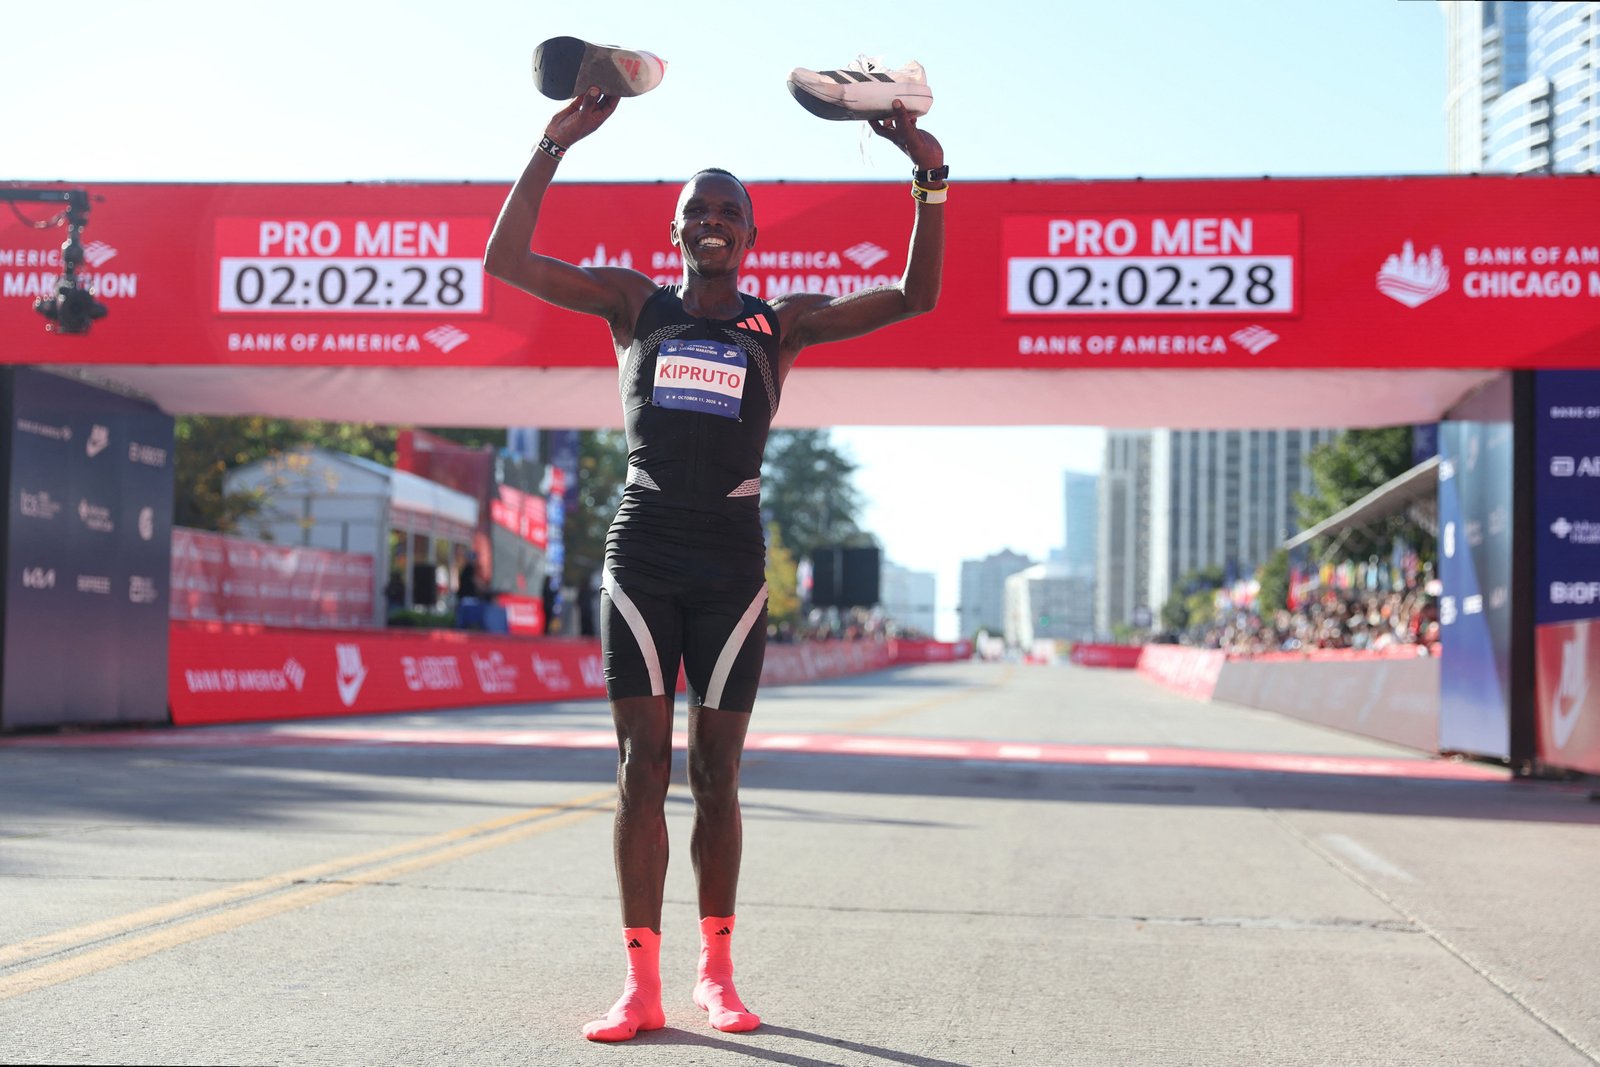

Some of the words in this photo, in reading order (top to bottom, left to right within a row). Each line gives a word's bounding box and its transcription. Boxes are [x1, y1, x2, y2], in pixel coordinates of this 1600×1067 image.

[259, 221, 341, 256] PRO
[354, 221, 449, 256] MEN
[1048, 219, 1138, 256] PRO
[1151, 218, 1253, 255] MEN
[0, 249, 64, 267] MERIC
[743, 251, 841, 269] AMERICA
[1464, 246, 1527, 265] BANK
[1530, 246, 1561, 265] OF
[235, 265, 465, 306] 02:02:28
[1028, 264, 1275, 307] 02:02:28
[1463, 270, 1581, 298] CHICAGO
[228, 332, 287, 351] BANK
[290, 333, 319, 352] OF
[322, 334, 421, 352] AMERICA
[1018, 336, 1082, 354] BANK
[1086, 335, 1118, 354] OF
[1120, 335, 1227, 354] AMERICA
[660, 364, 740, 388] KIPRUTO
